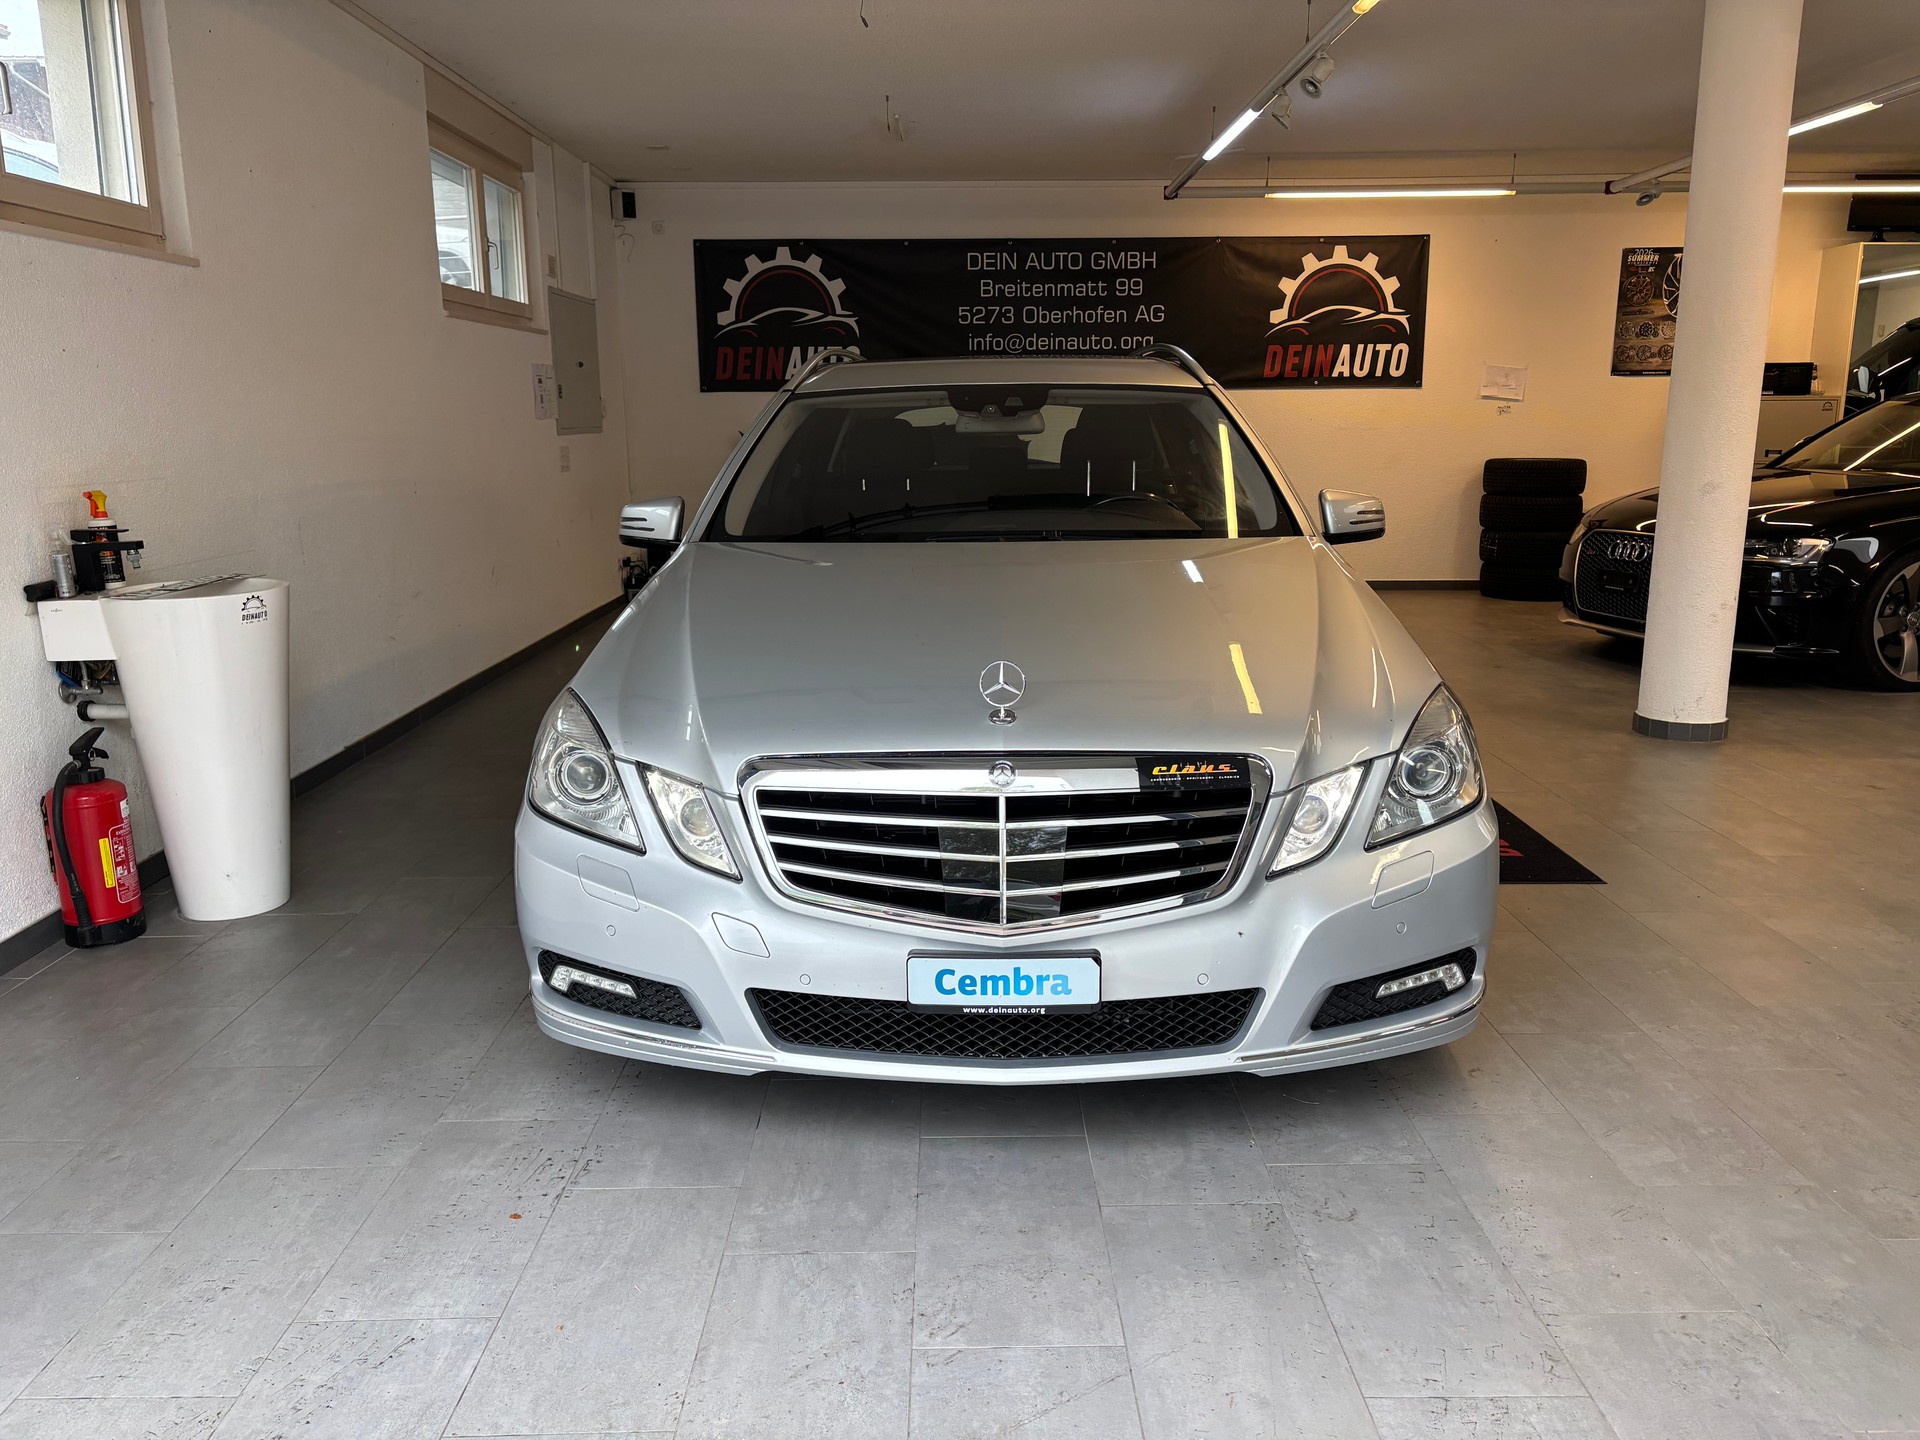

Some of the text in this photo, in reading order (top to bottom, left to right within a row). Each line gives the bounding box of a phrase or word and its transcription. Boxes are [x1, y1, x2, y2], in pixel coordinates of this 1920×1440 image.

[967, 251, 1157, 270] DEIN AUTO GMBH
[980, 278, 1143, 297] Breitenmatt 99
[958, 304, 1165, 324] 5273 Oberhofen AG
[1263, 342, 1410, 378] DEINAUTO
[1152, 763, 1233, 775] claus
[934, 966, 1072, 996] Cembra
[962, 1006, 1046, 1015] www.deinauto.org
